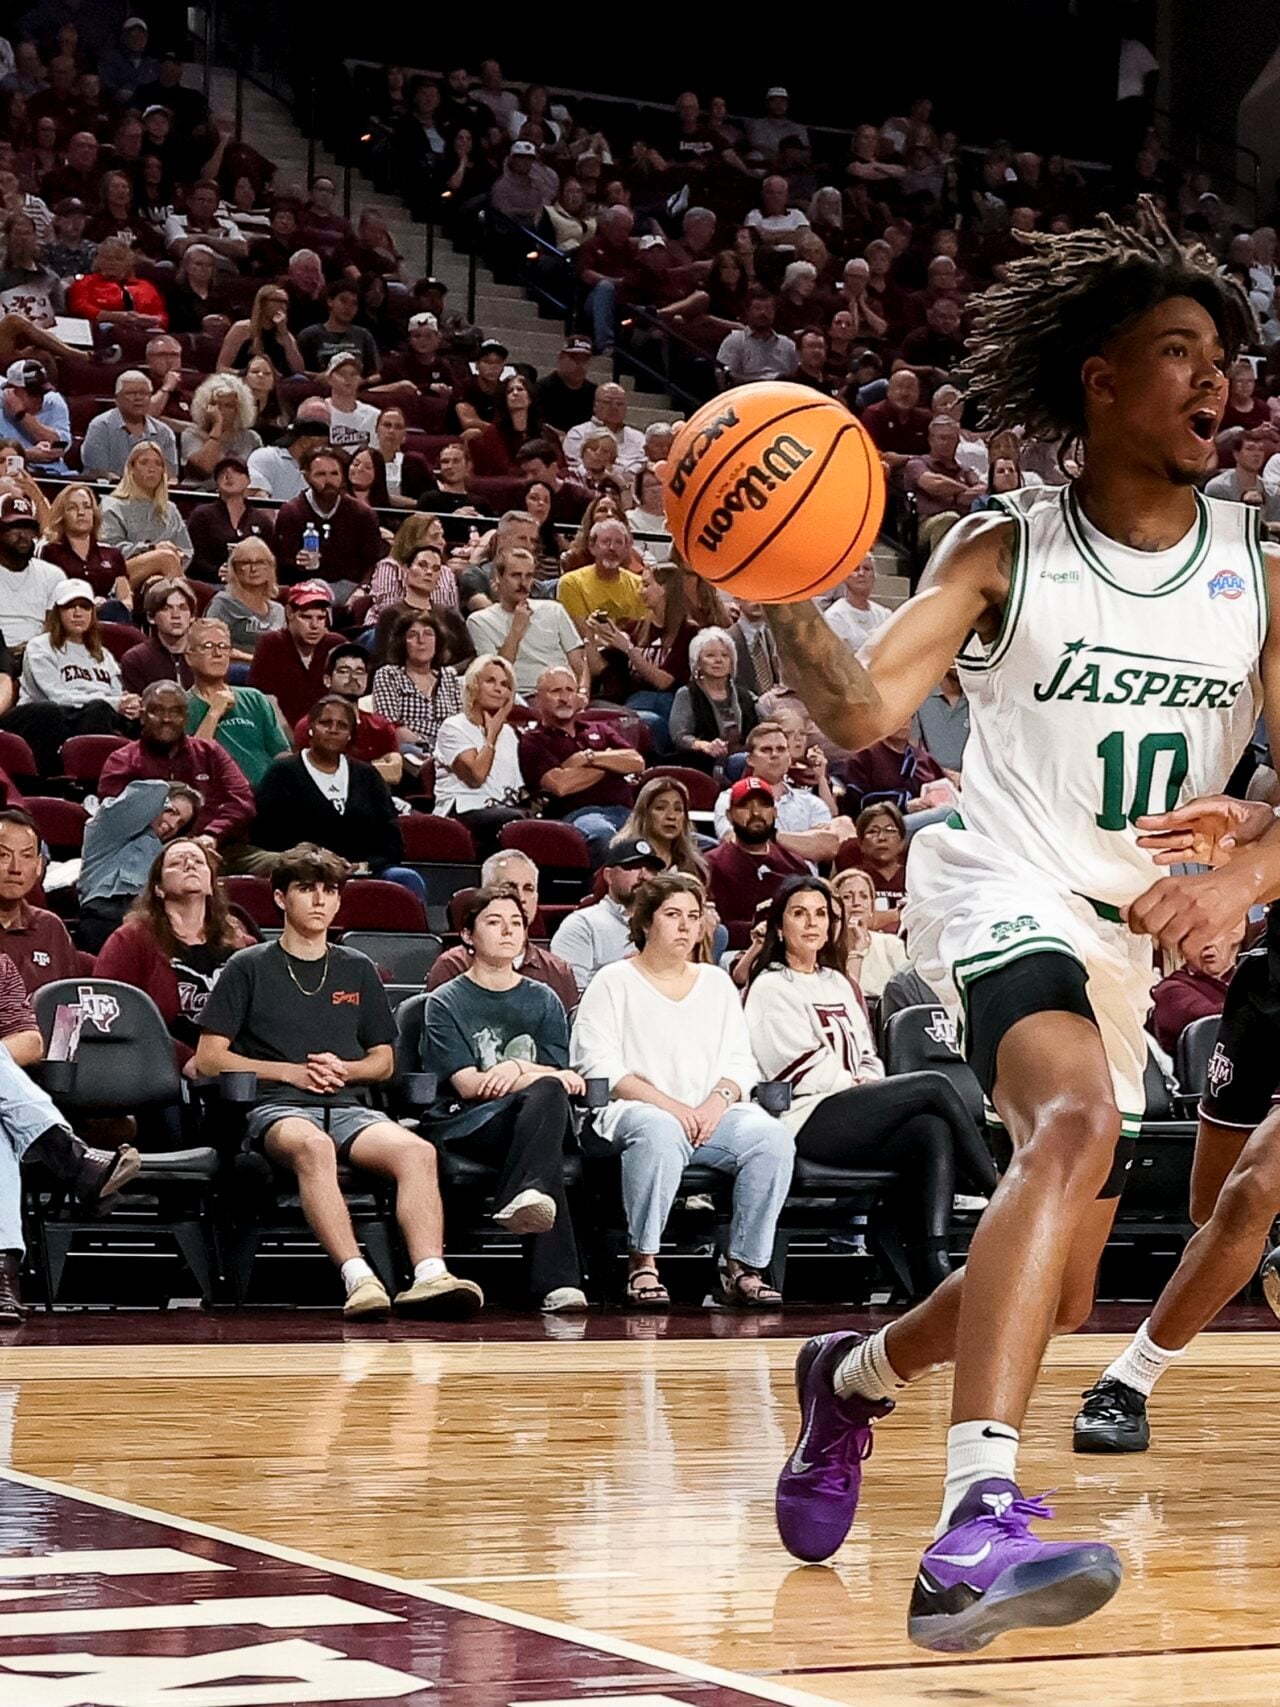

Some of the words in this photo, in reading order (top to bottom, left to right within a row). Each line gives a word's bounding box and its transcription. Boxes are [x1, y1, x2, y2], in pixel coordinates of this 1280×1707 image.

[670, 408, 739, 497] NCAA
[696, 434, 814, 553] Wilson
[1034, 656, 1244, 709] JASPERS
[1096, 731, 1189, 831] 10
